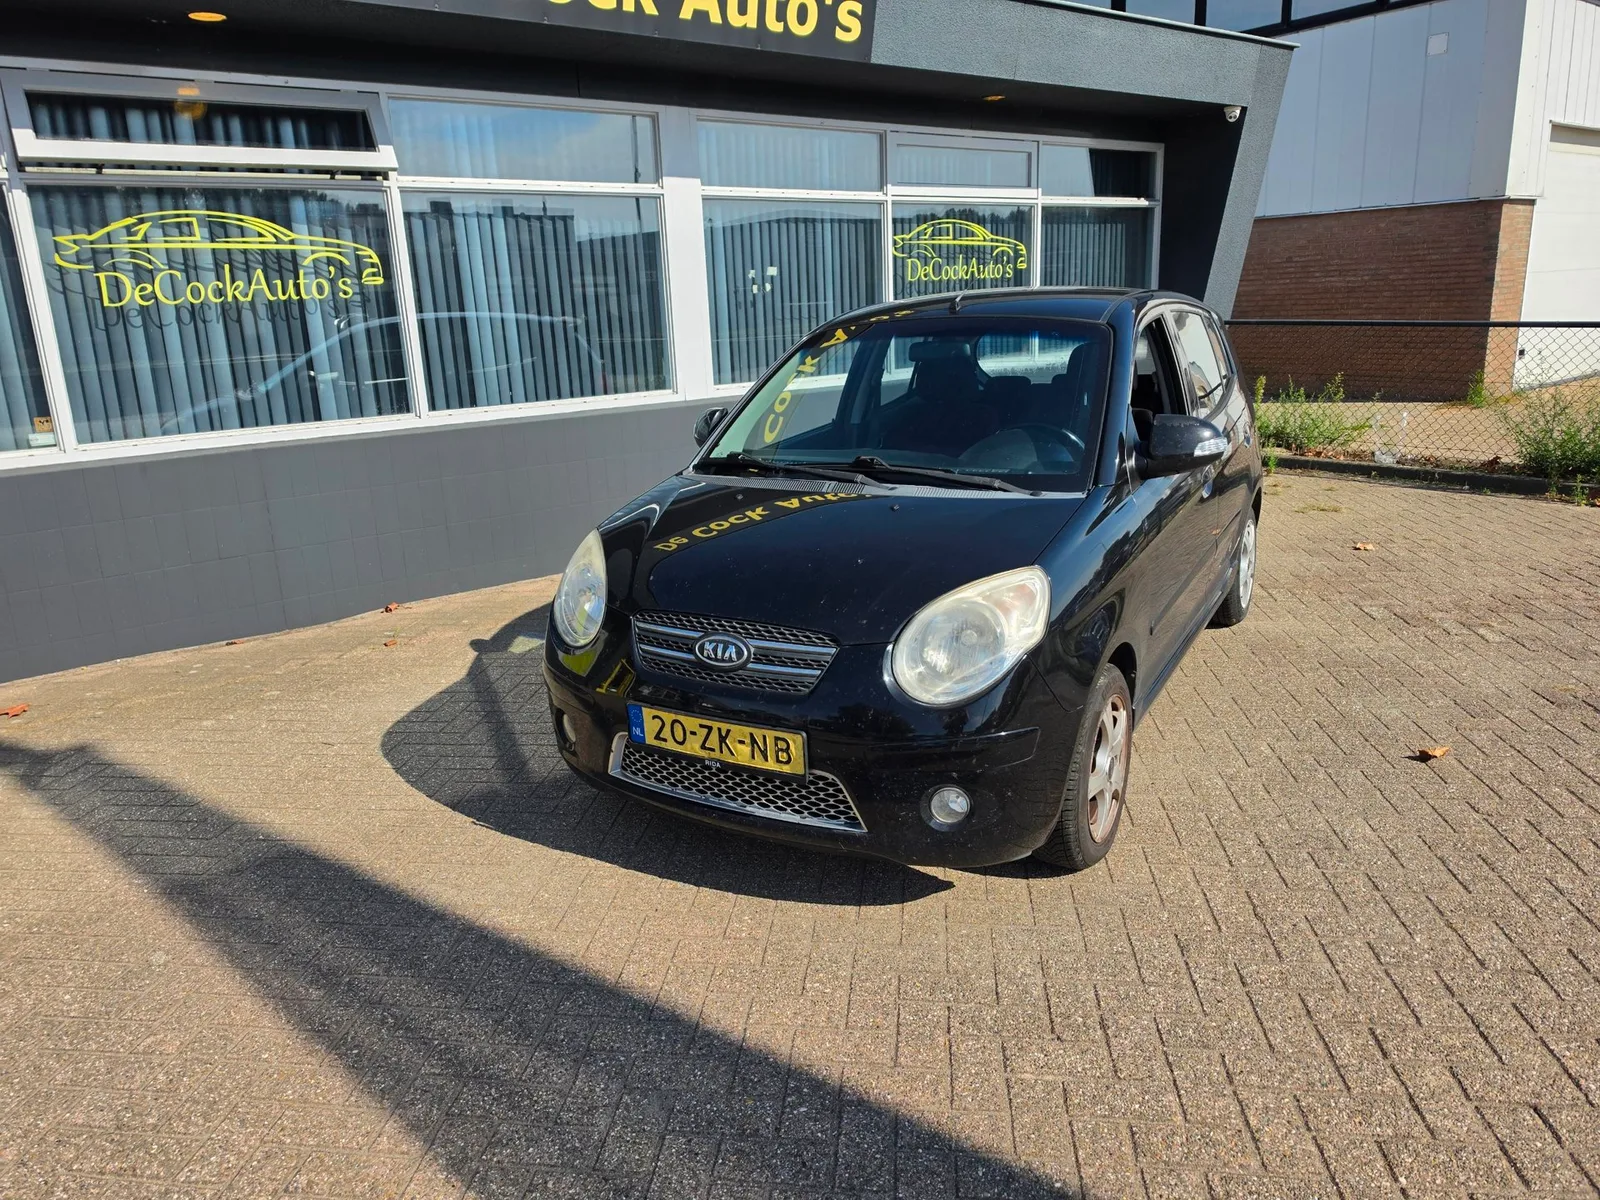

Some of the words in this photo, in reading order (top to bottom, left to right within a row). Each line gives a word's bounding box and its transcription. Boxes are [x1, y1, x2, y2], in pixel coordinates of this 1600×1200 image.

[678, 0, 863, 42] Autos
[906, 254, 1013, 281] DeCockAuto's
[94, 263, 354, 307] DeCockAuto's
[703, 641, 738, 661] KIA
[632, 727, 644, 737] NL
[651, 714, 793, 765] 20-ZK-NB
